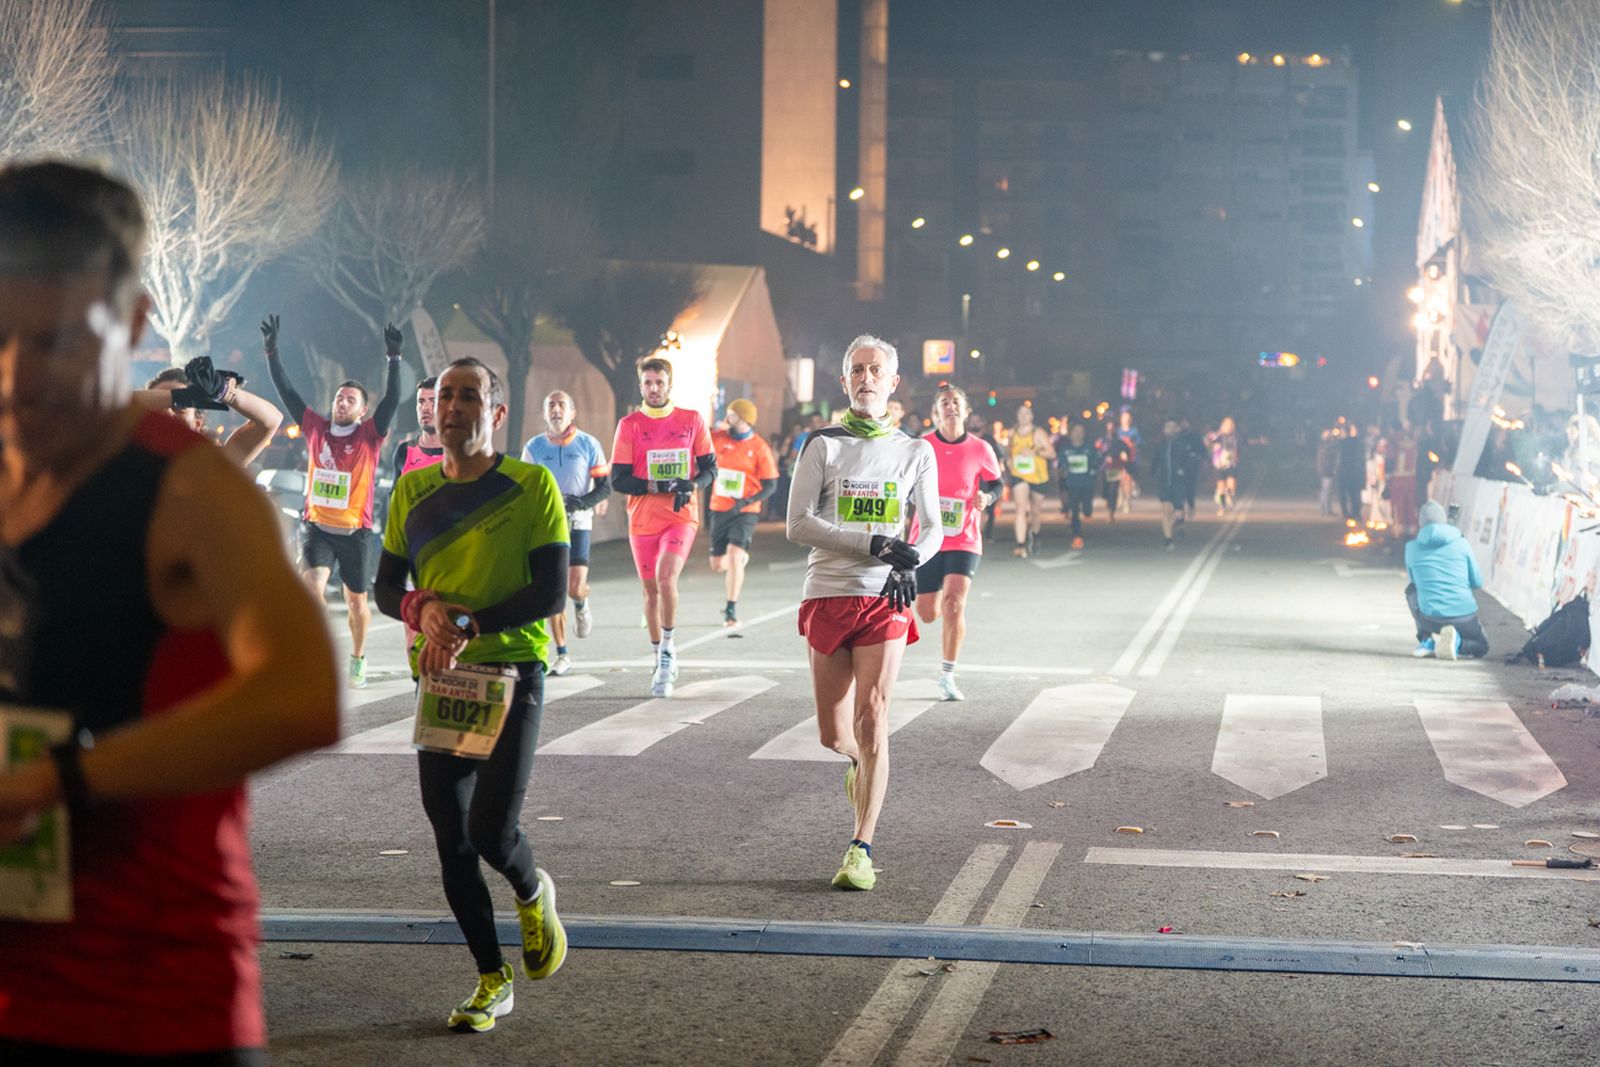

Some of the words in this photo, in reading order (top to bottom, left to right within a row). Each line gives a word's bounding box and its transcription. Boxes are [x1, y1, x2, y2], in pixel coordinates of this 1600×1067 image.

[657, 463, 682, 476] 4077
[853, 498, 886, 517] 949
[942, 511, 957, 524] 95
[430, 685, 448, 695] SAN
[441, 678, 467, 688] NOCHE
[468, 680, 478, 690] DE
[438, 698, 492, 727] 6021
